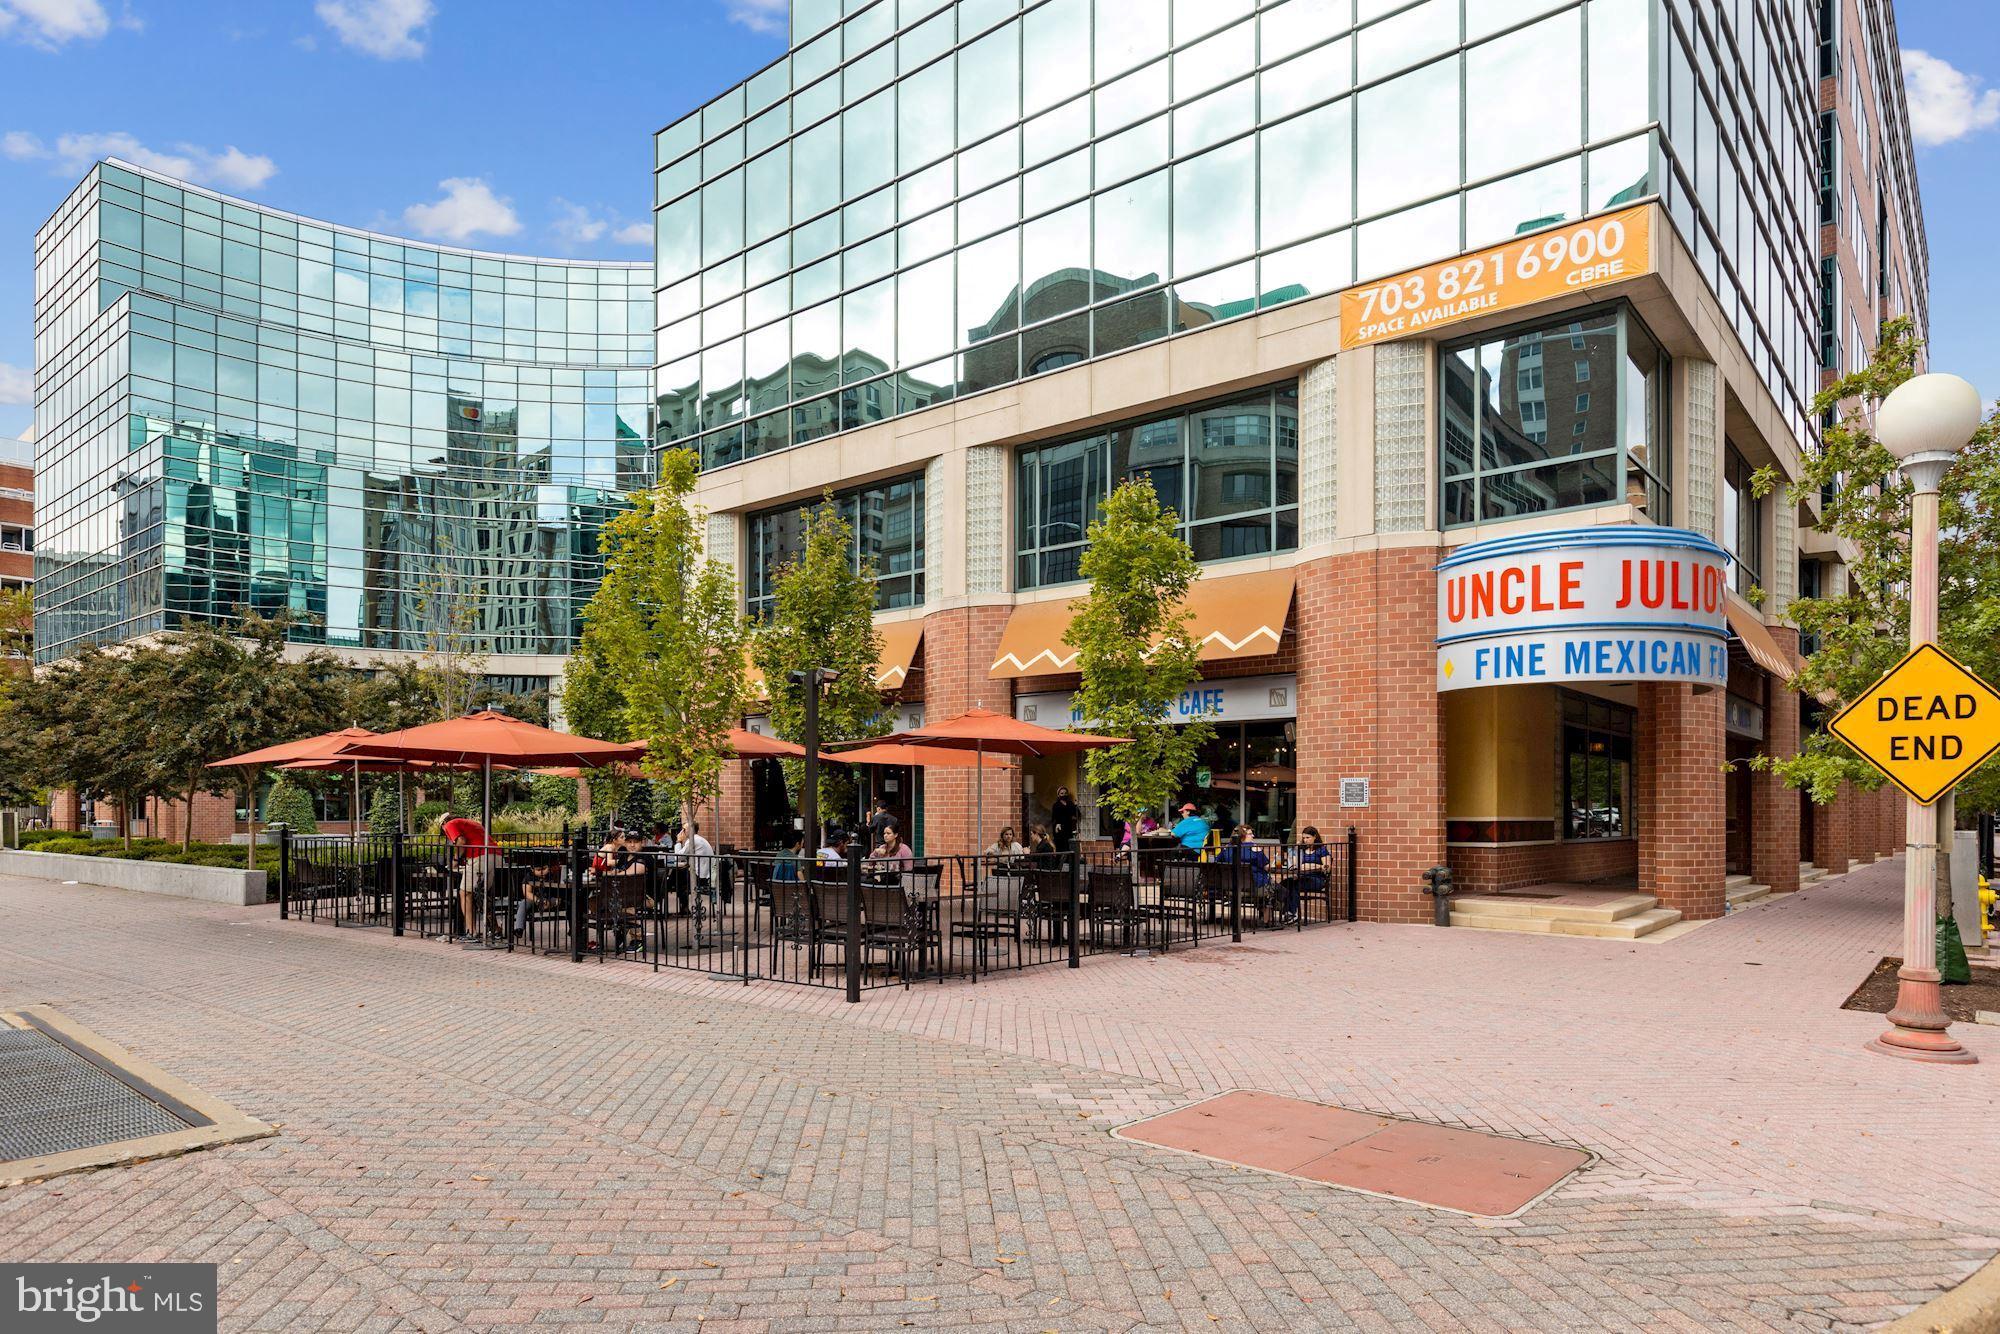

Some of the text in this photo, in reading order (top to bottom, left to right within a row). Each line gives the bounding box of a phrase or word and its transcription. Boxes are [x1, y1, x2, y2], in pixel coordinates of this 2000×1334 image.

[1357, 220, 1626, 323] 703 821 6900
[1565, 258, 1624, 286] CBRE
[1358, 292, 1498, 340] SPACE AVAILABLE
[1447, 561, 1585, 624] UNCLE
[1475, 643, 1546, 681] FINE
[1565, 640, 1700, 676] MEXICAN
[1179, 688, 1224, 716] CAFE
[1878, 694, 1977, 722] DEAD
[1890, 735, 1963, 761] END
